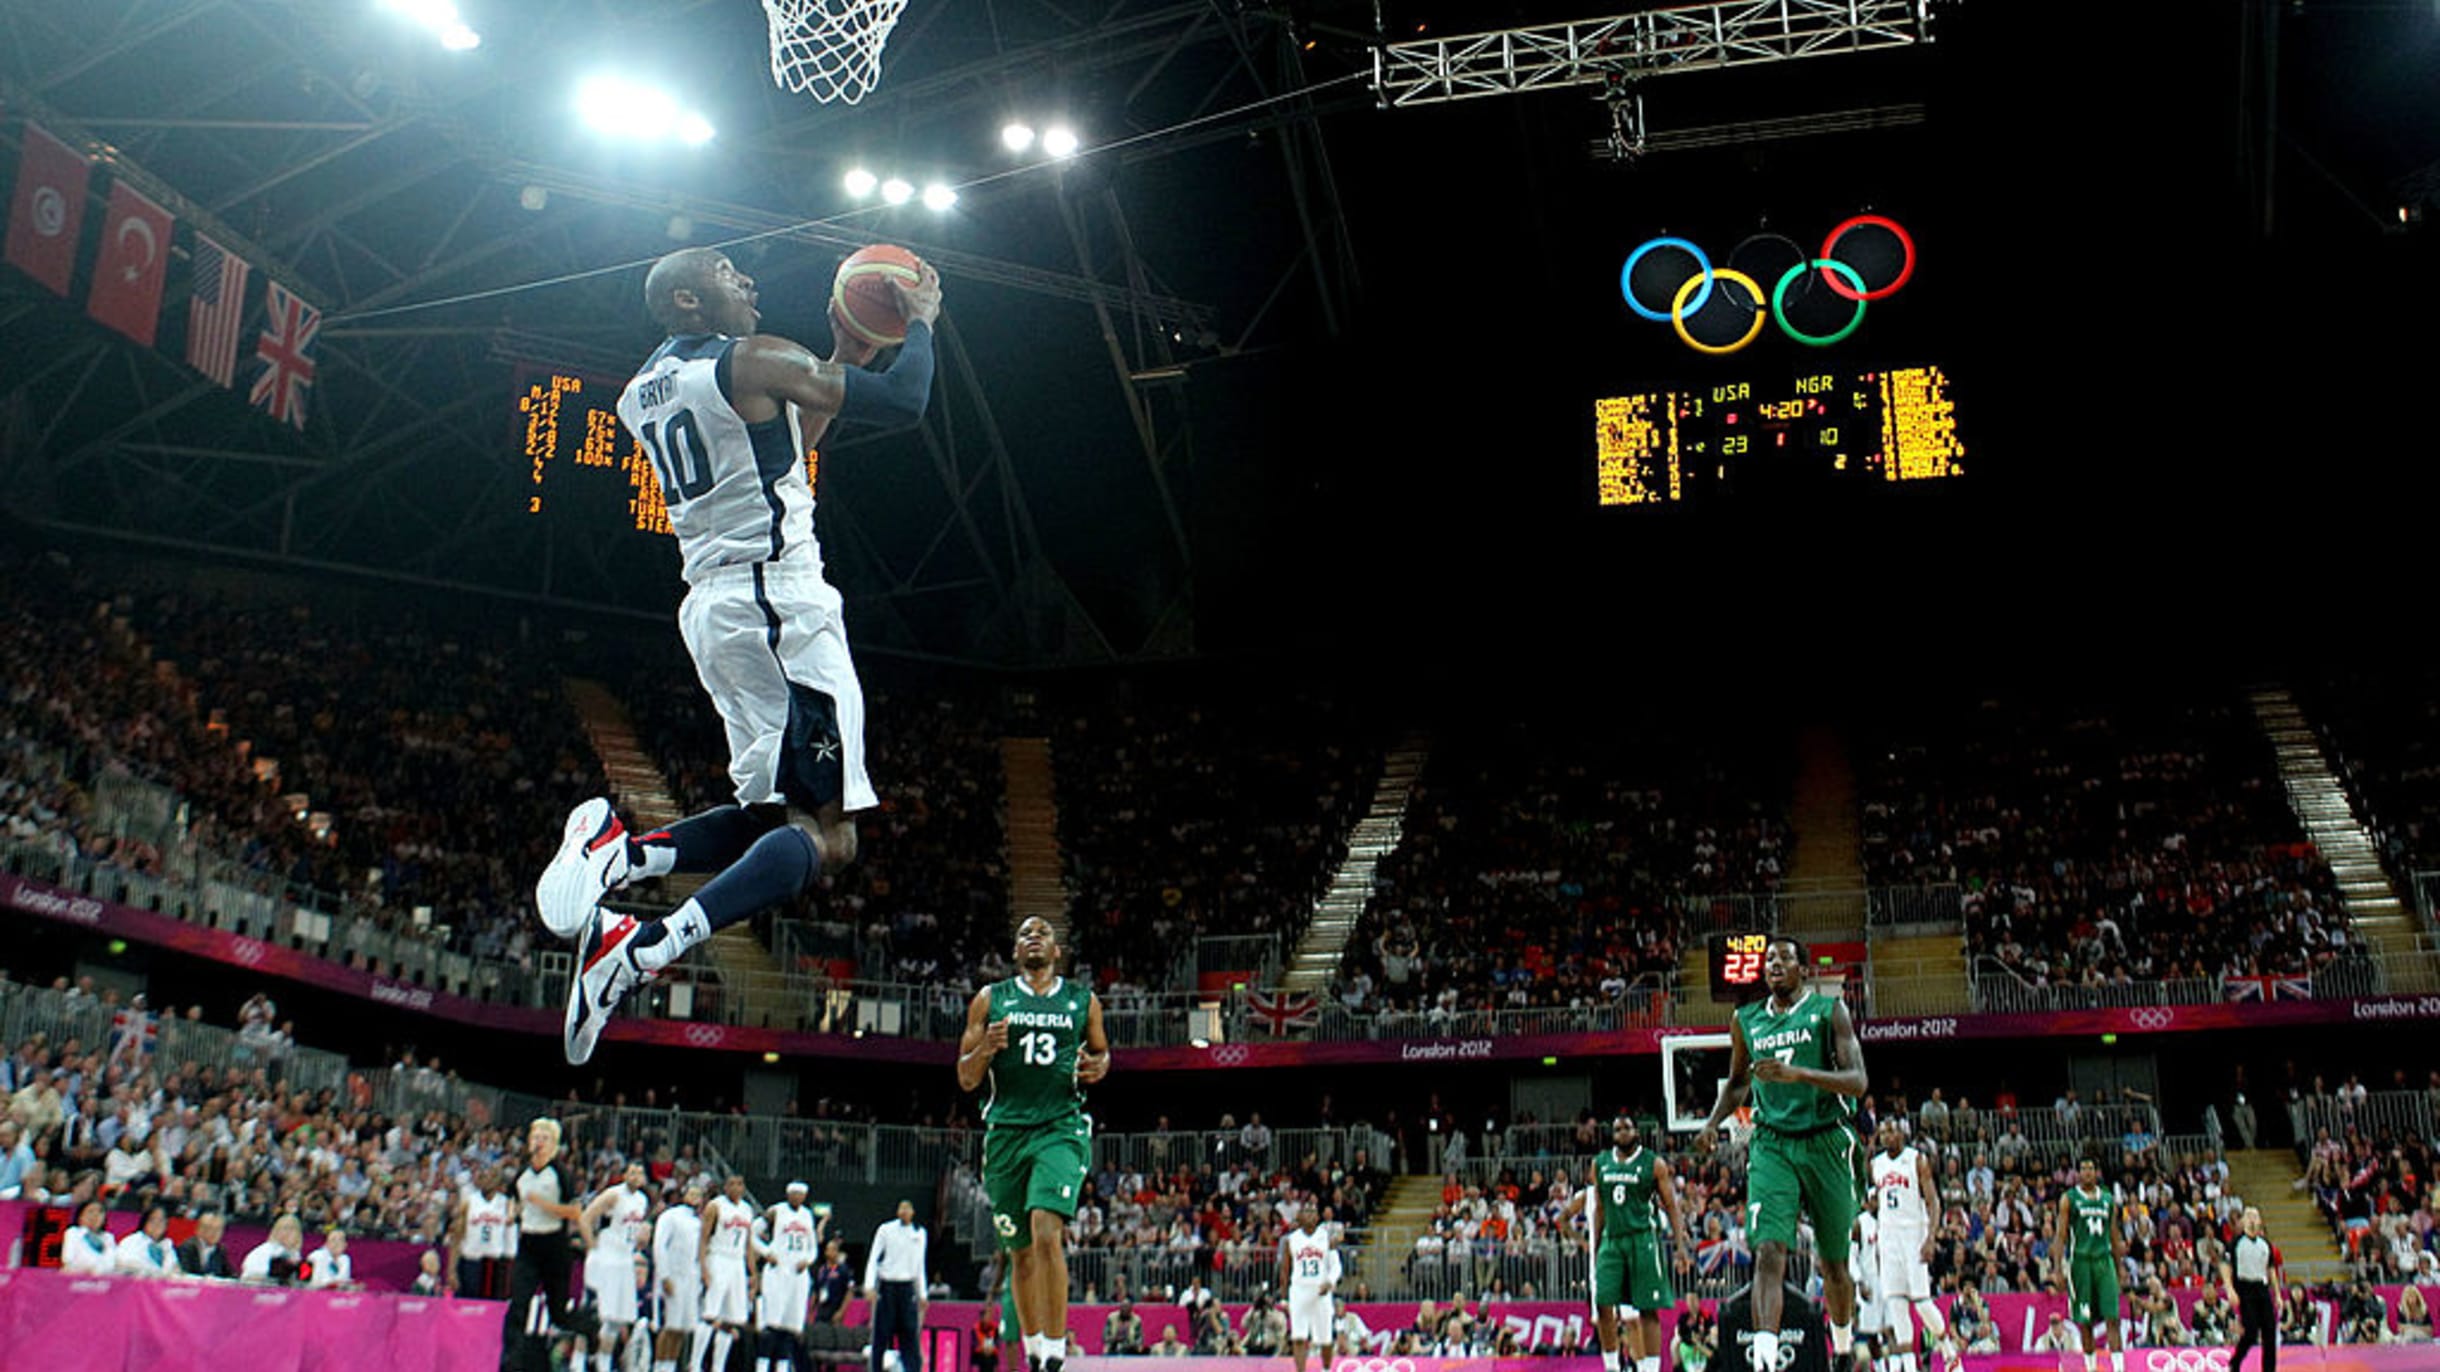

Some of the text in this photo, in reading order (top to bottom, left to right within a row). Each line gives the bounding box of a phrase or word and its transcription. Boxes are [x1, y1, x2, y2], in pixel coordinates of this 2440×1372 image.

[552, 375, 582, 394] USA
[1712, 383, 1750, 403] USA
[1796, 375, 1833, 394] NGR
[1759, 400, 1804, 419] 4:20
[1722, 435, 1749, 454] 23
[1820, 427, 1839, 446] 10
[641, 408, 715, 508] 10
[1727, 935, 1766, 953] 4:20
[1724, 953, 1760, 980] 22
[2353, 997, 2415, 1018] London
[1008, 1010, 1073, 1030] NIGERIA
[1860, 1018, 1958, 1040] London 2012
[1018, 1030, 1056, 1066] 13
[1402, 1040, 1492, 1059] London 2012
[1753, 1028, 1812, 1052] NIGERIA
[1613, 1184, 1626, 1206] 6
[1302, 1259, 1319, 1278] 13
